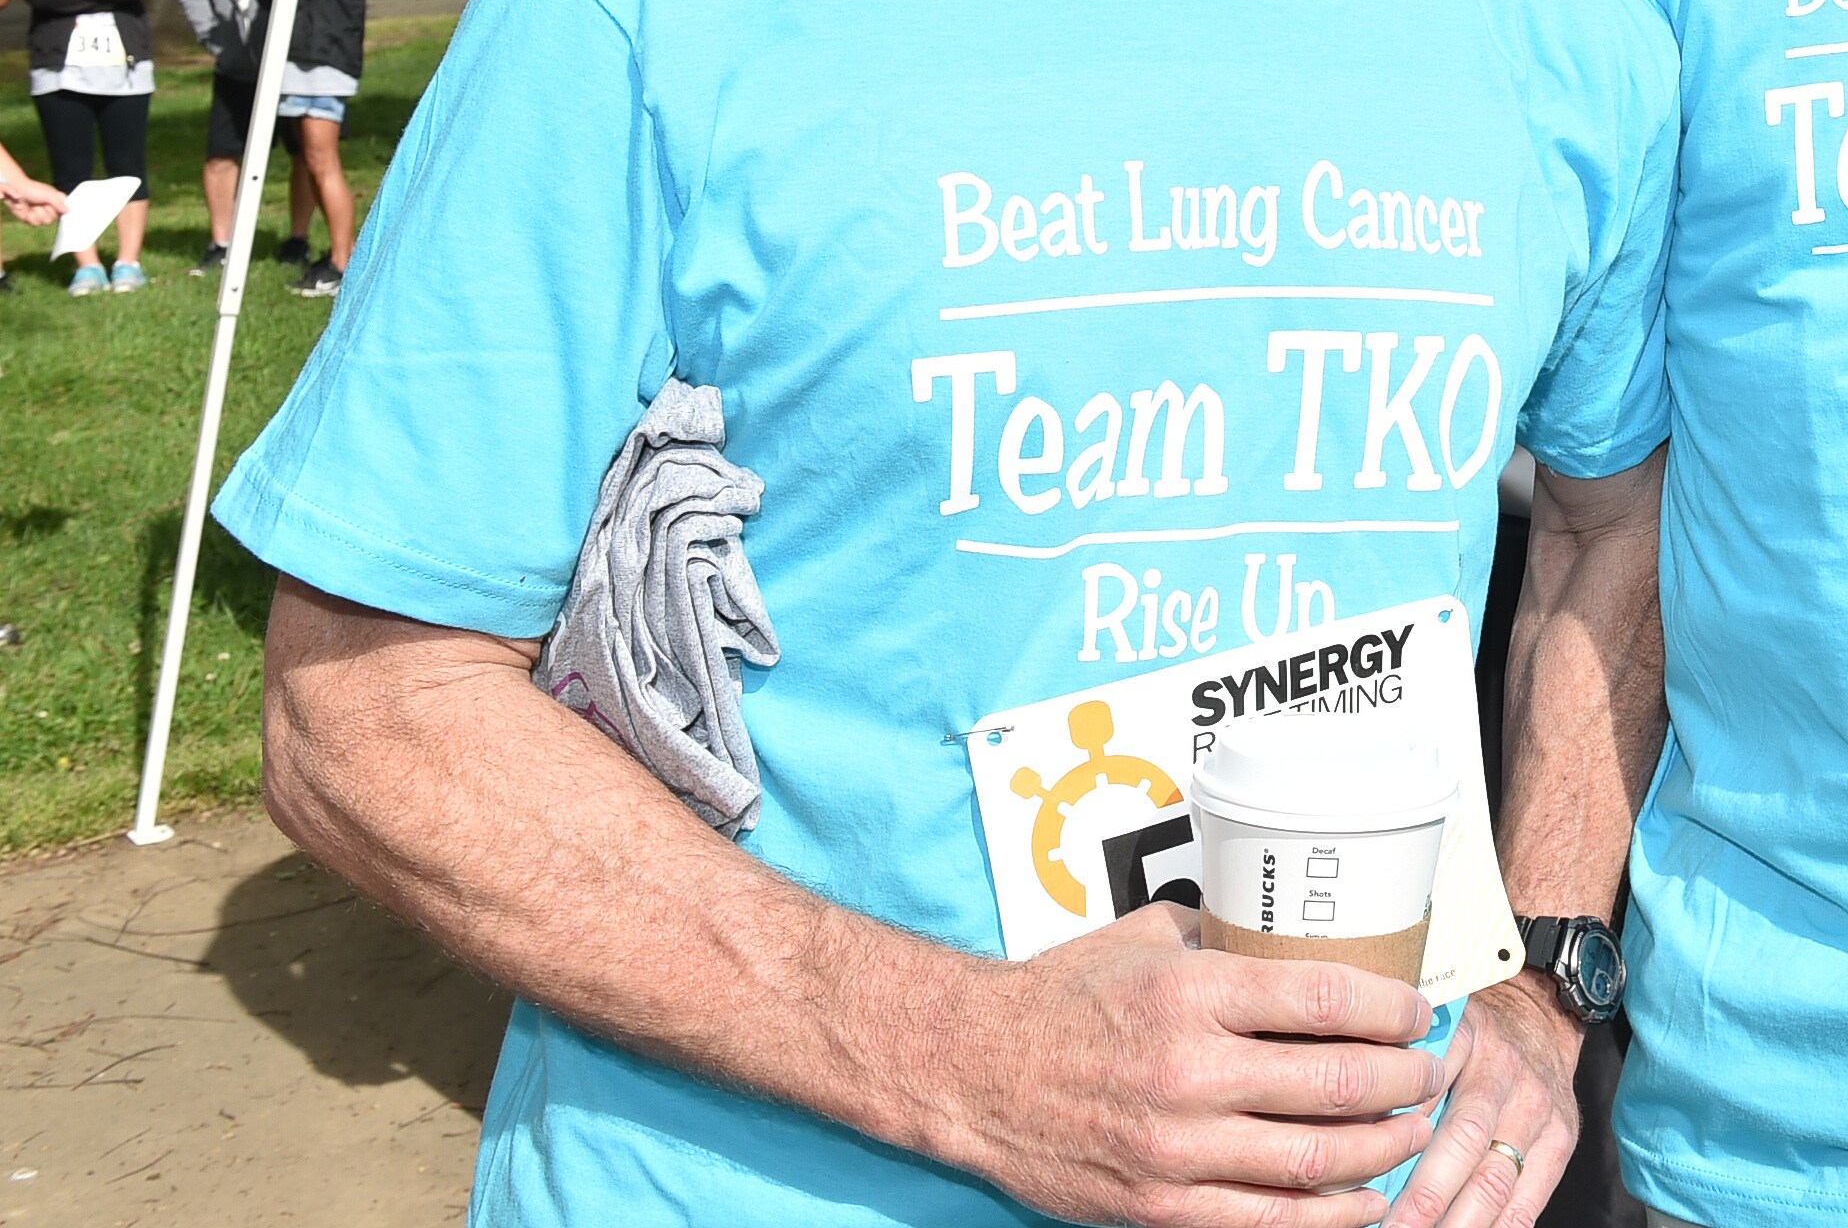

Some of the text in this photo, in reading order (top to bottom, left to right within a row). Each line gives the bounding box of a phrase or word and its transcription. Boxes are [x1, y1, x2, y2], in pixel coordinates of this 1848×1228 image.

[937, 159, 1485, 268] Beat Lung Cancer
[911, 330, 1502, 516] Team TKO
[1077, 562, 1221, 662] Rise
[1191, 624, 1415, 726] SYNERGY
[1308, 889, 1332, 898] Shots
[1312, 847, 1337, 855] Decaf
